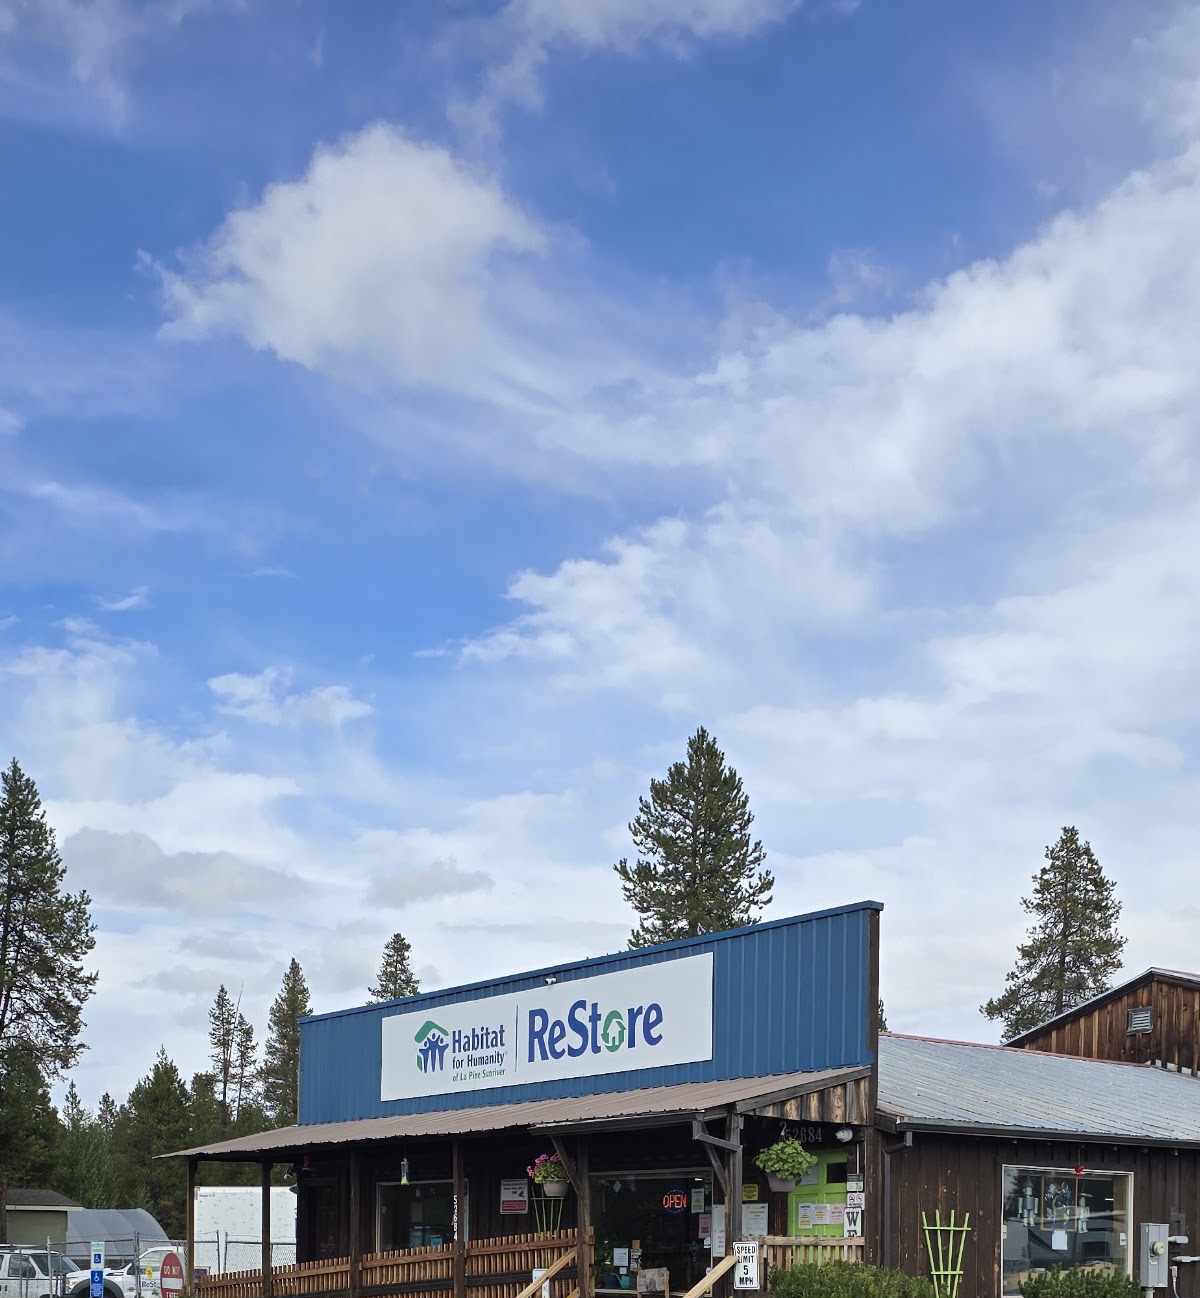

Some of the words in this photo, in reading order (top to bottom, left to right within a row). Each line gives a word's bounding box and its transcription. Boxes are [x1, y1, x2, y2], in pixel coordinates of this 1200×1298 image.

[527, 1000, 663, 1063] ReStore
[452, 1024, 505, 1054] Habitat
[452, 1056, 464, 1069] for
[467, 1050, 505, 1067] Humanity
[452, 1073, 459, 1082] of
[460, 1073, 467, 1081] La
[482, 1068, 505, 1078] Sunriver
[662, 1194, 687, 1208] OPEN
[736, 1245, 756, 1255] SPEED
[737, 1255, 754, 1264] LIMIT
[163, 1265, 171, 1275] DO
[172, 1265, 181, 1275] NOT
[743, 1265, 749, 1275] 5
[739, 1276, 754, 1286] MPH
